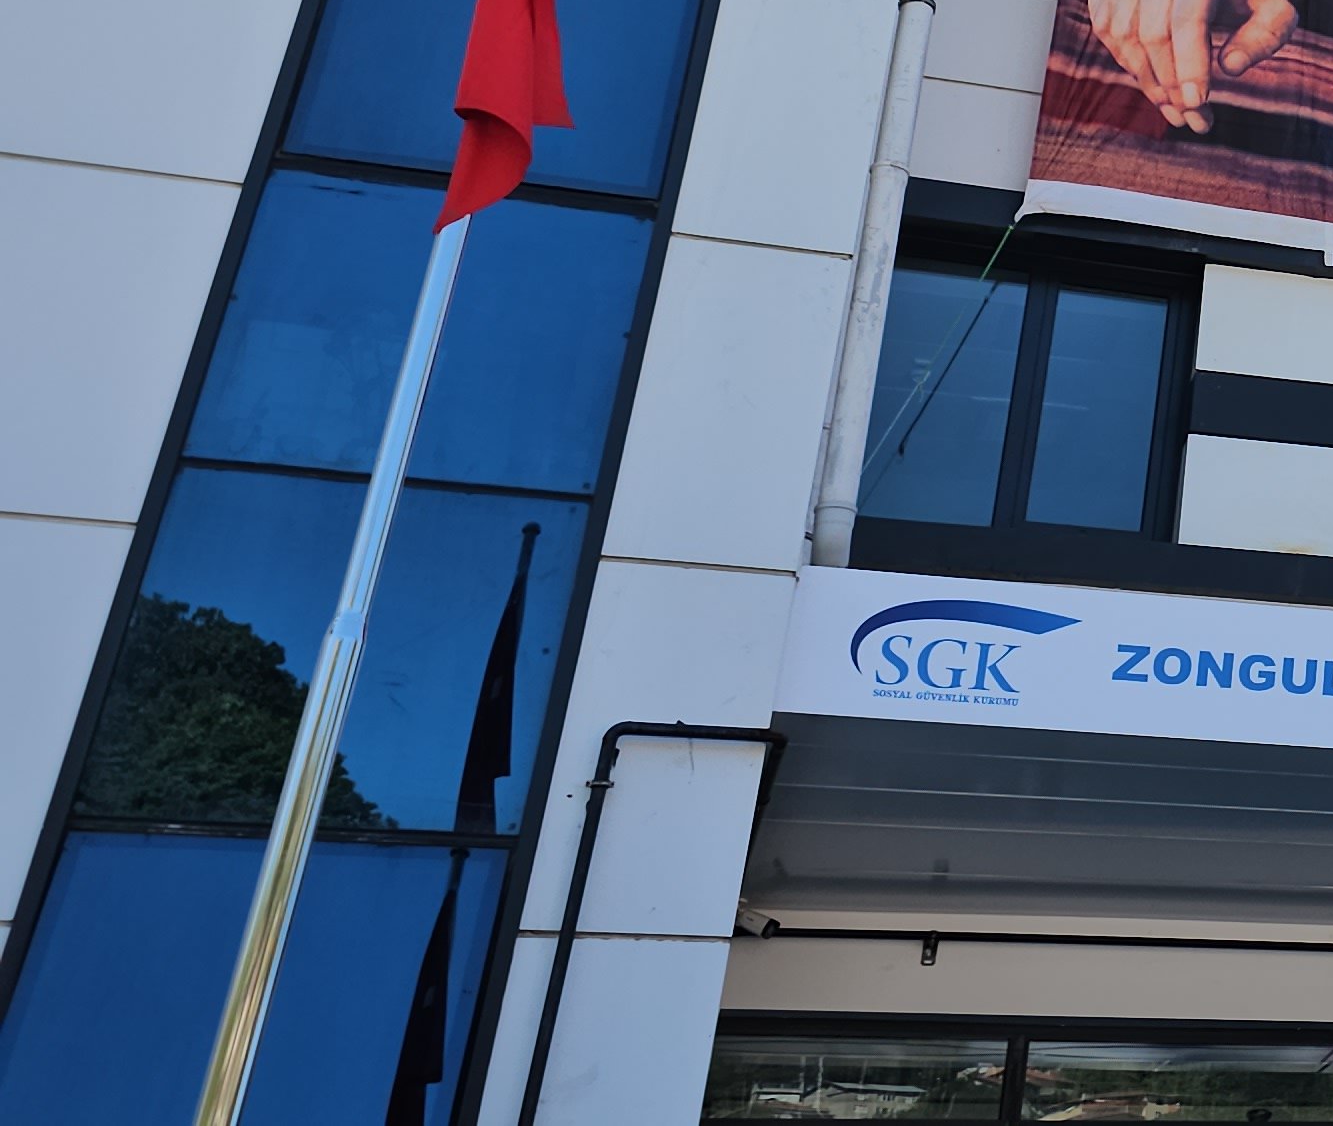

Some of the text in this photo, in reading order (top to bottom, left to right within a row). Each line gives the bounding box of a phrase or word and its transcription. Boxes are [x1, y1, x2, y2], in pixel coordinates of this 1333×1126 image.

[874, 634, 1022, 693] SGK
[872, 688, 1019, 707] SOSYAL GÜVENLİK KURUMU
